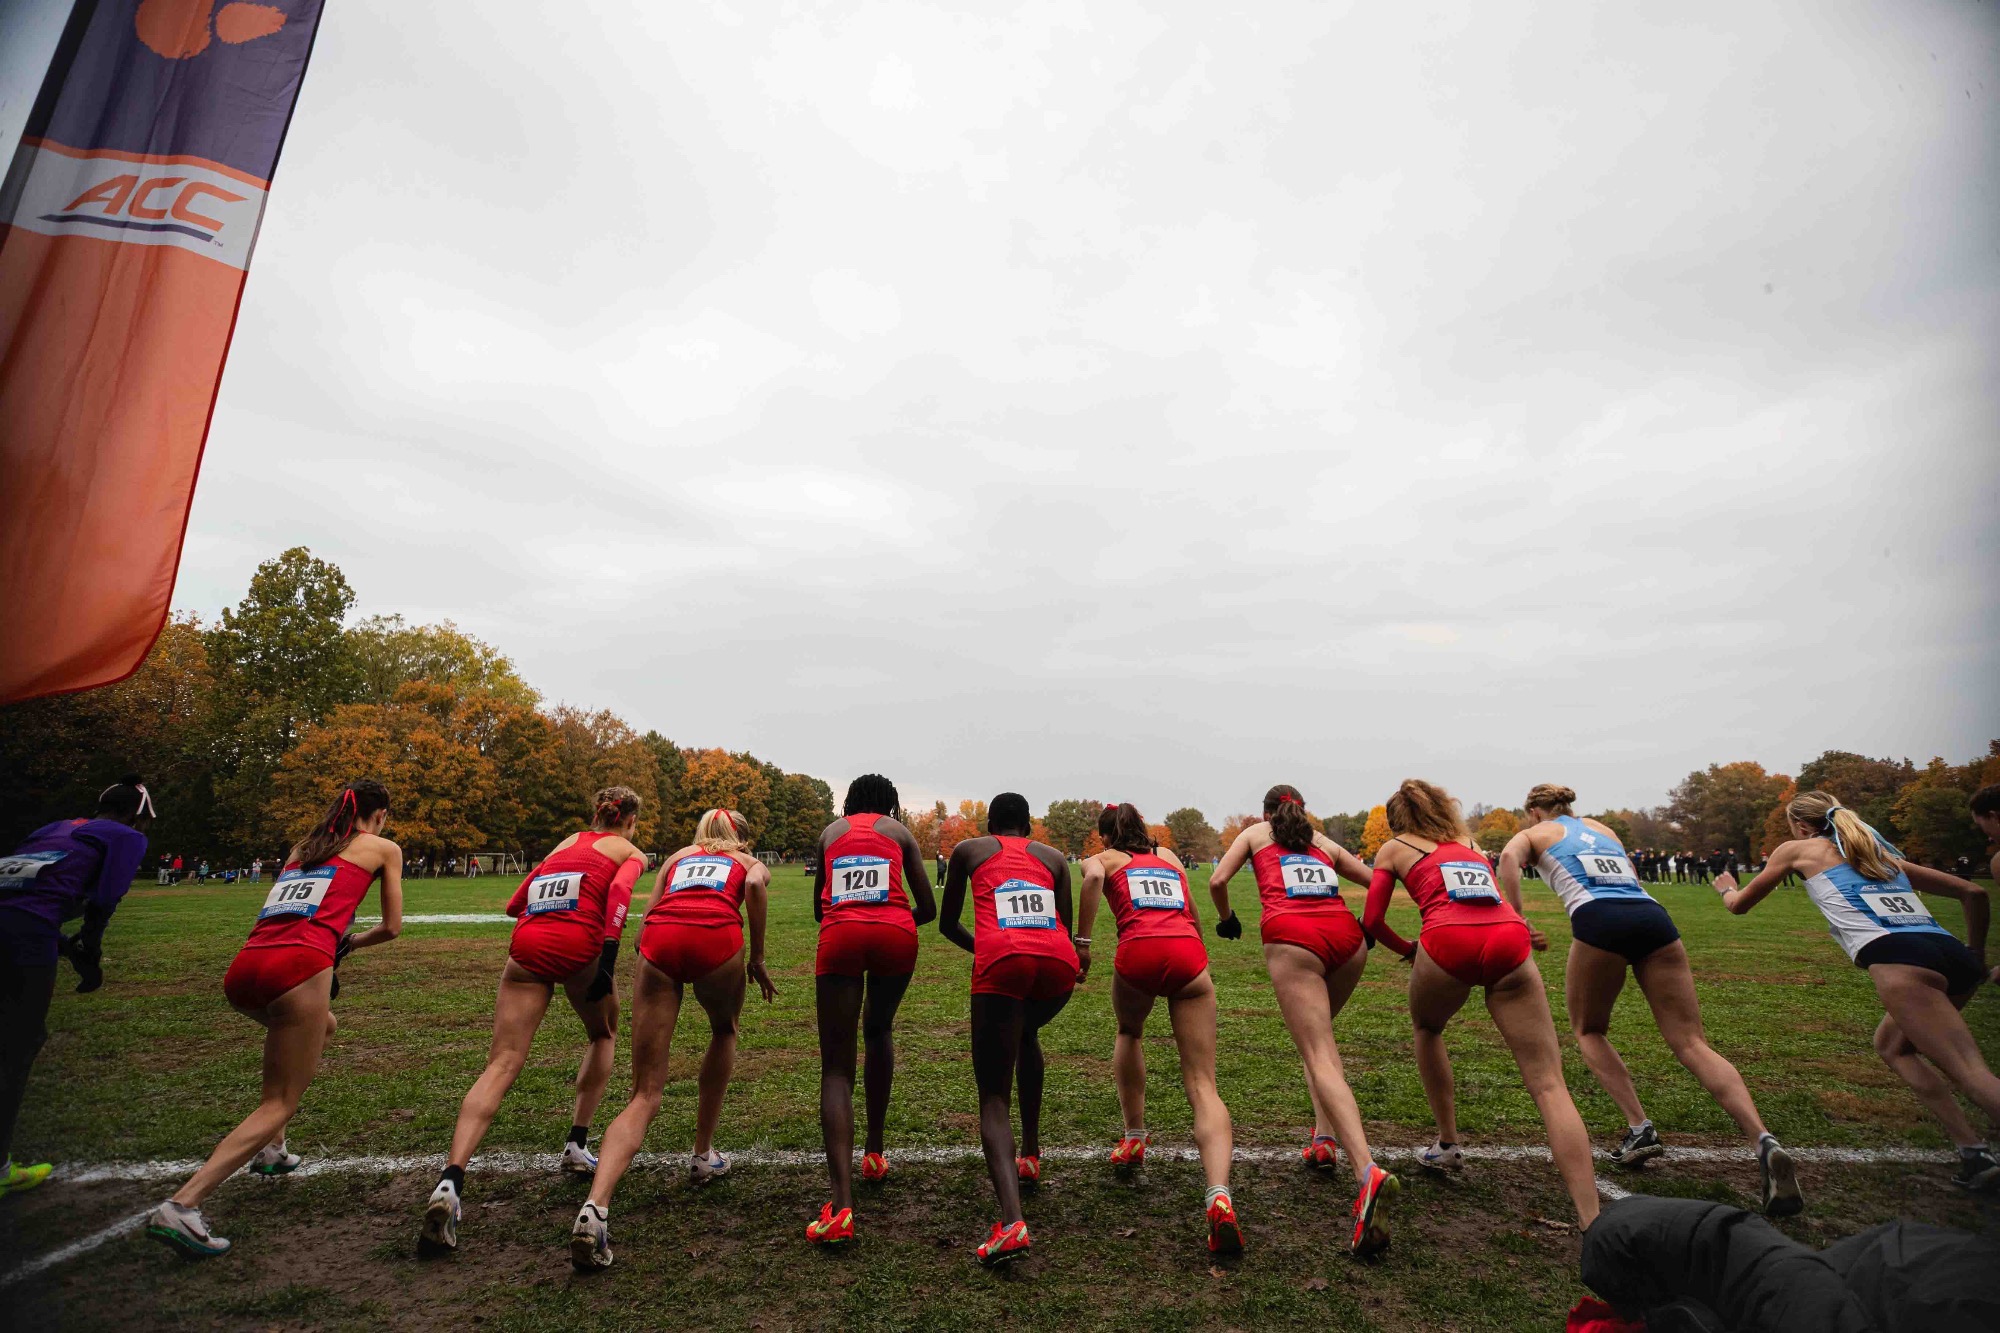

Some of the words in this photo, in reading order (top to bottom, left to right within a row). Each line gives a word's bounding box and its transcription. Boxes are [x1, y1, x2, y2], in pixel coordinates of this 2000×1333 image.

[62, 174, 249, 232] ACC
[838, 857, 858, 865] ACC
[1594, 858, 1622, 874] 88
[686, 865, 717, 878] 117
[842, 869, 878, 891] 120
[1293, 867, 1326, 883] 121
[1453, 871, 1492, 888] 122
[278, 882, 315, 902] 115
[538, 879, 569, 899] 119
[1001, 881, 1019, 889] ACC
[1139, 879, 1173, 896] 116
[1008, 893, 1044, 914] 118
[1879, 896, 1915, 913] 93
